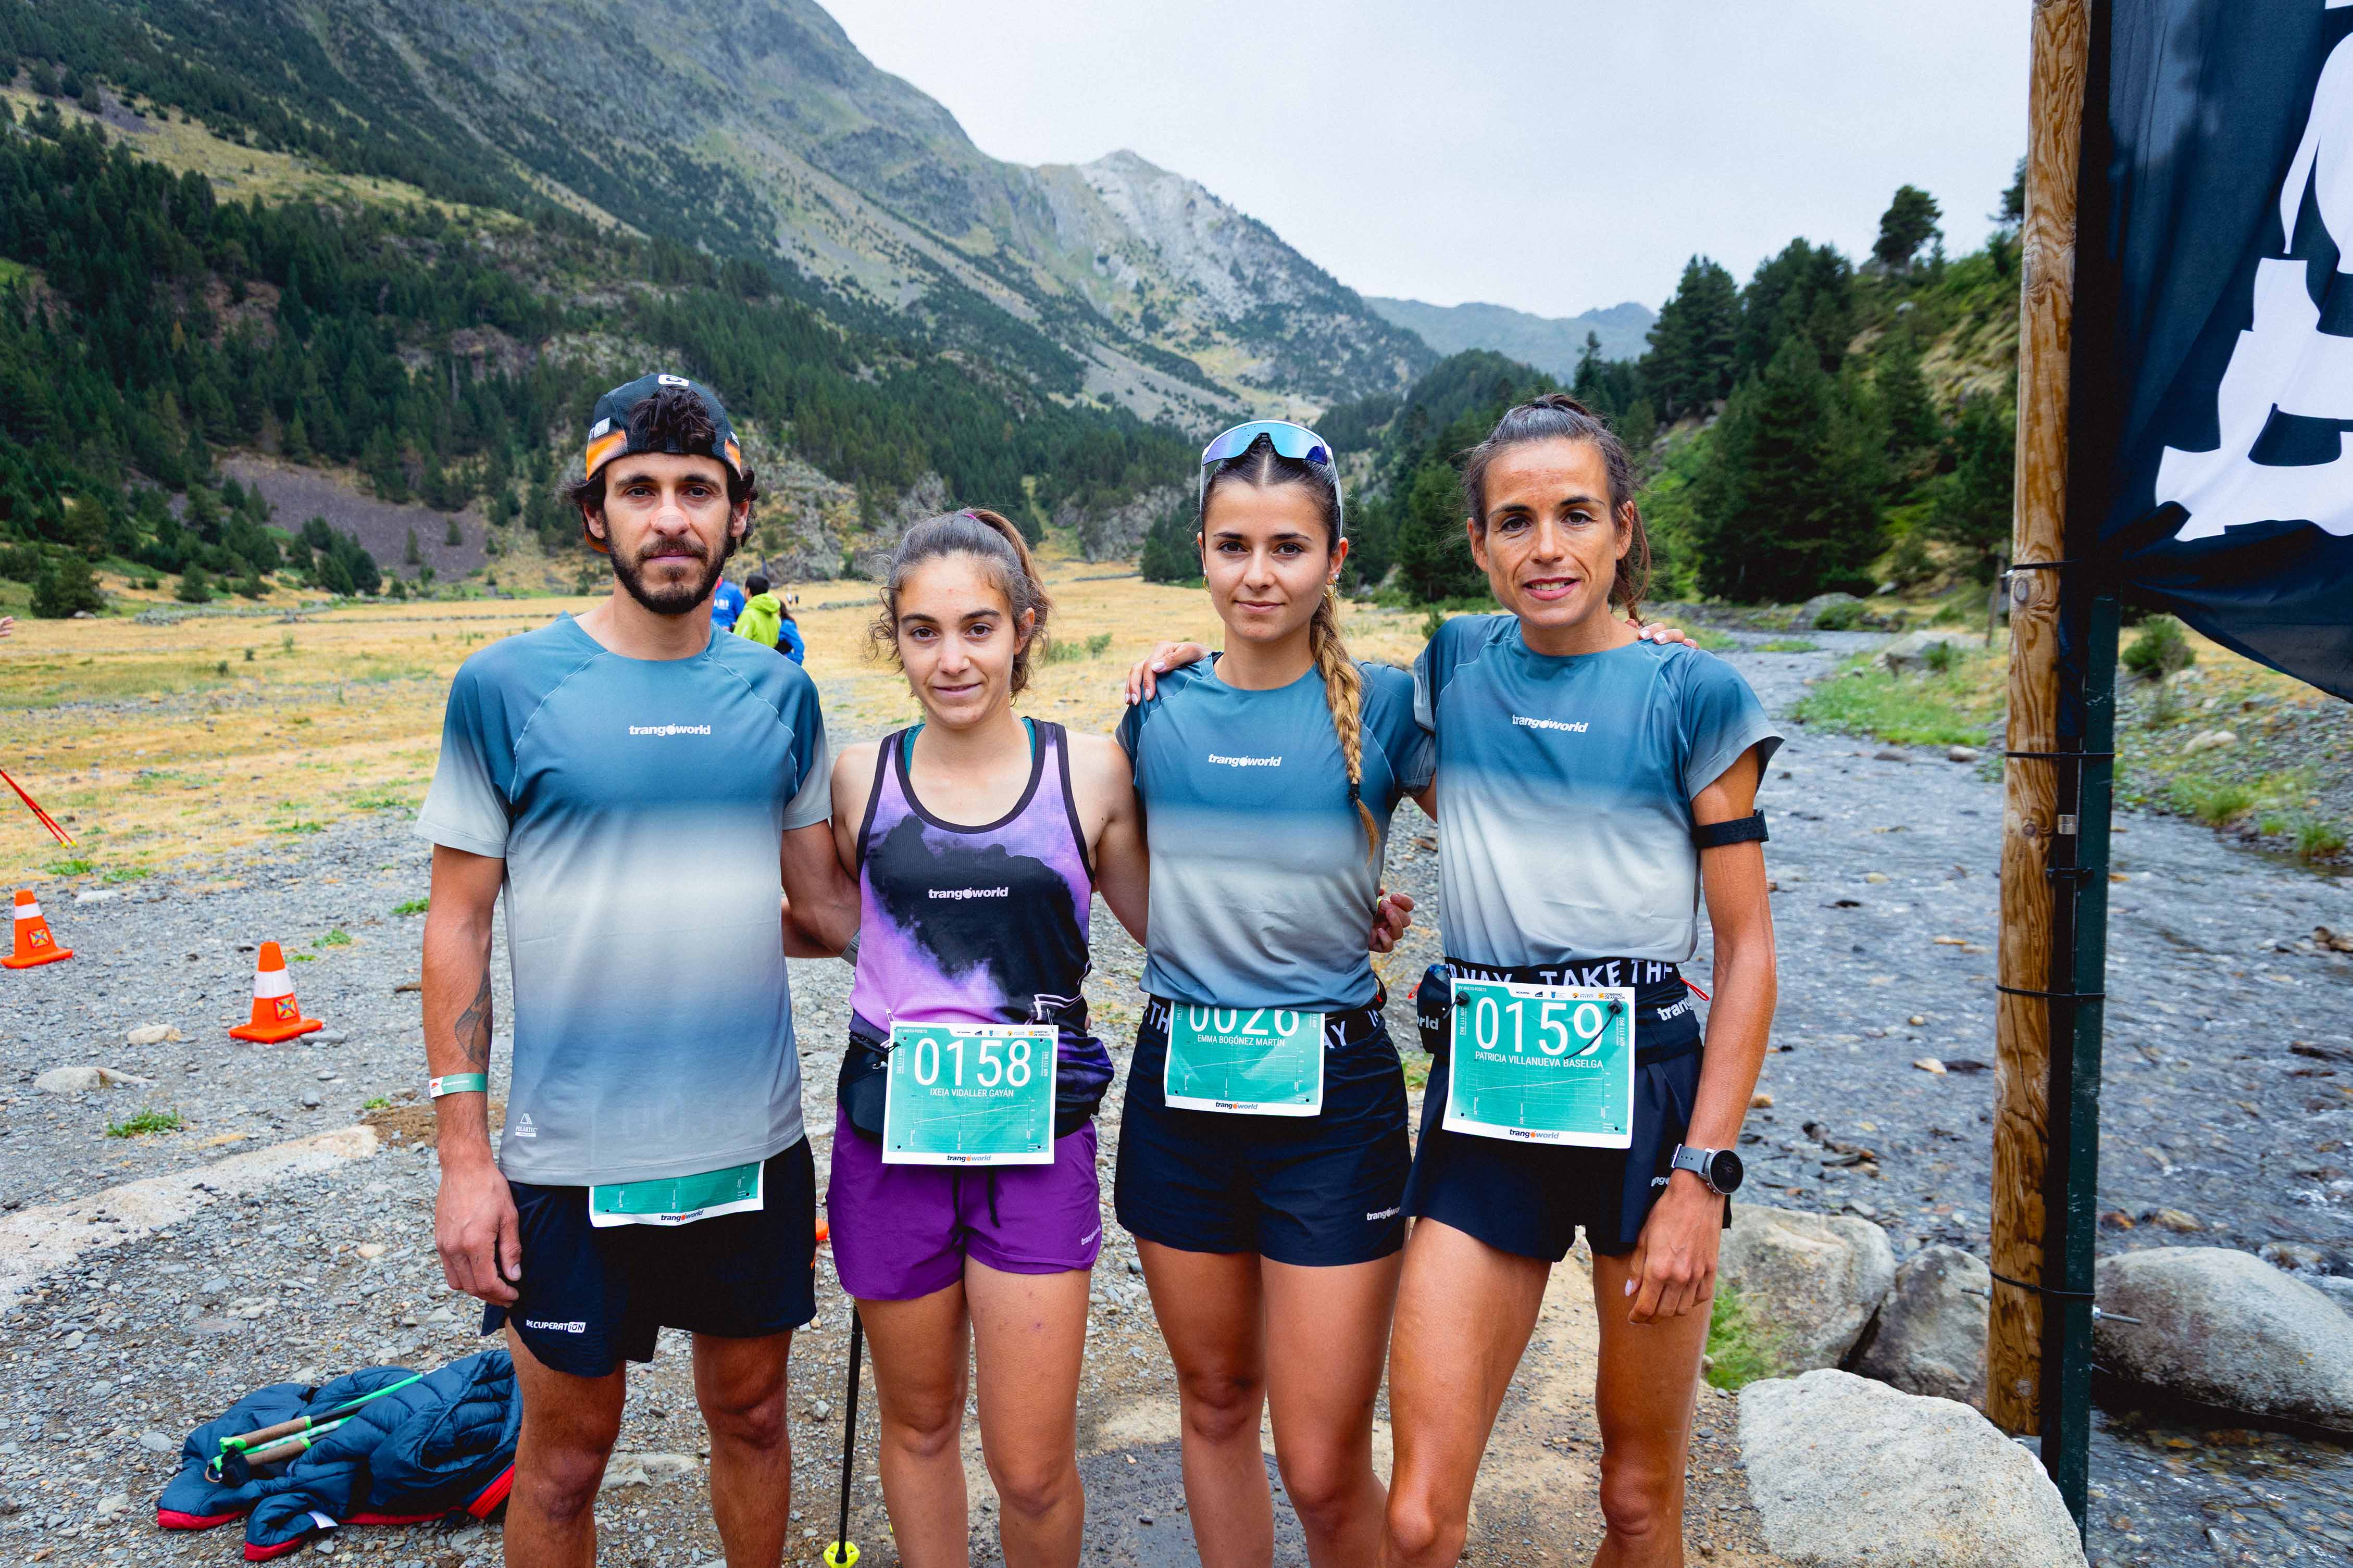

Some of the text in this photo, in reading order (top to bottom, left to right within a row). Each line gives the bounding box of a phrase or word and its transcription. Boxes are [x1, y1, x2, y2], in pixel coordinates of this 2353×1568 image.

[629, 723, 711, 736] trangoworld
[1512, 714, 1588, 733] trangoworld
[1208, 754, 1282, 767] trangoworld
[928, 887, 1009, 900] trangoworld
[1539, 960, 1621, 987] TAKE
[1475, 997, 1603, 1056] 0159
[1198, 1035, 1285, 1046] EMMA BOGÓNEZ MARTÍN
[914, 1037, 1031, 1087] 0158
[1475, 1051, 1603, 1068] PATRICIA VILLANUEVA BASELGA
[930, 1087, 1014, 1097] IXEIA VIDALLER GAYÁN
[1215, 1101, 1258, 1110] trangoworld
[1510, 1129, 1559, 1139] trangoworld
[661, 1210, 704, 1222] trangoworld
